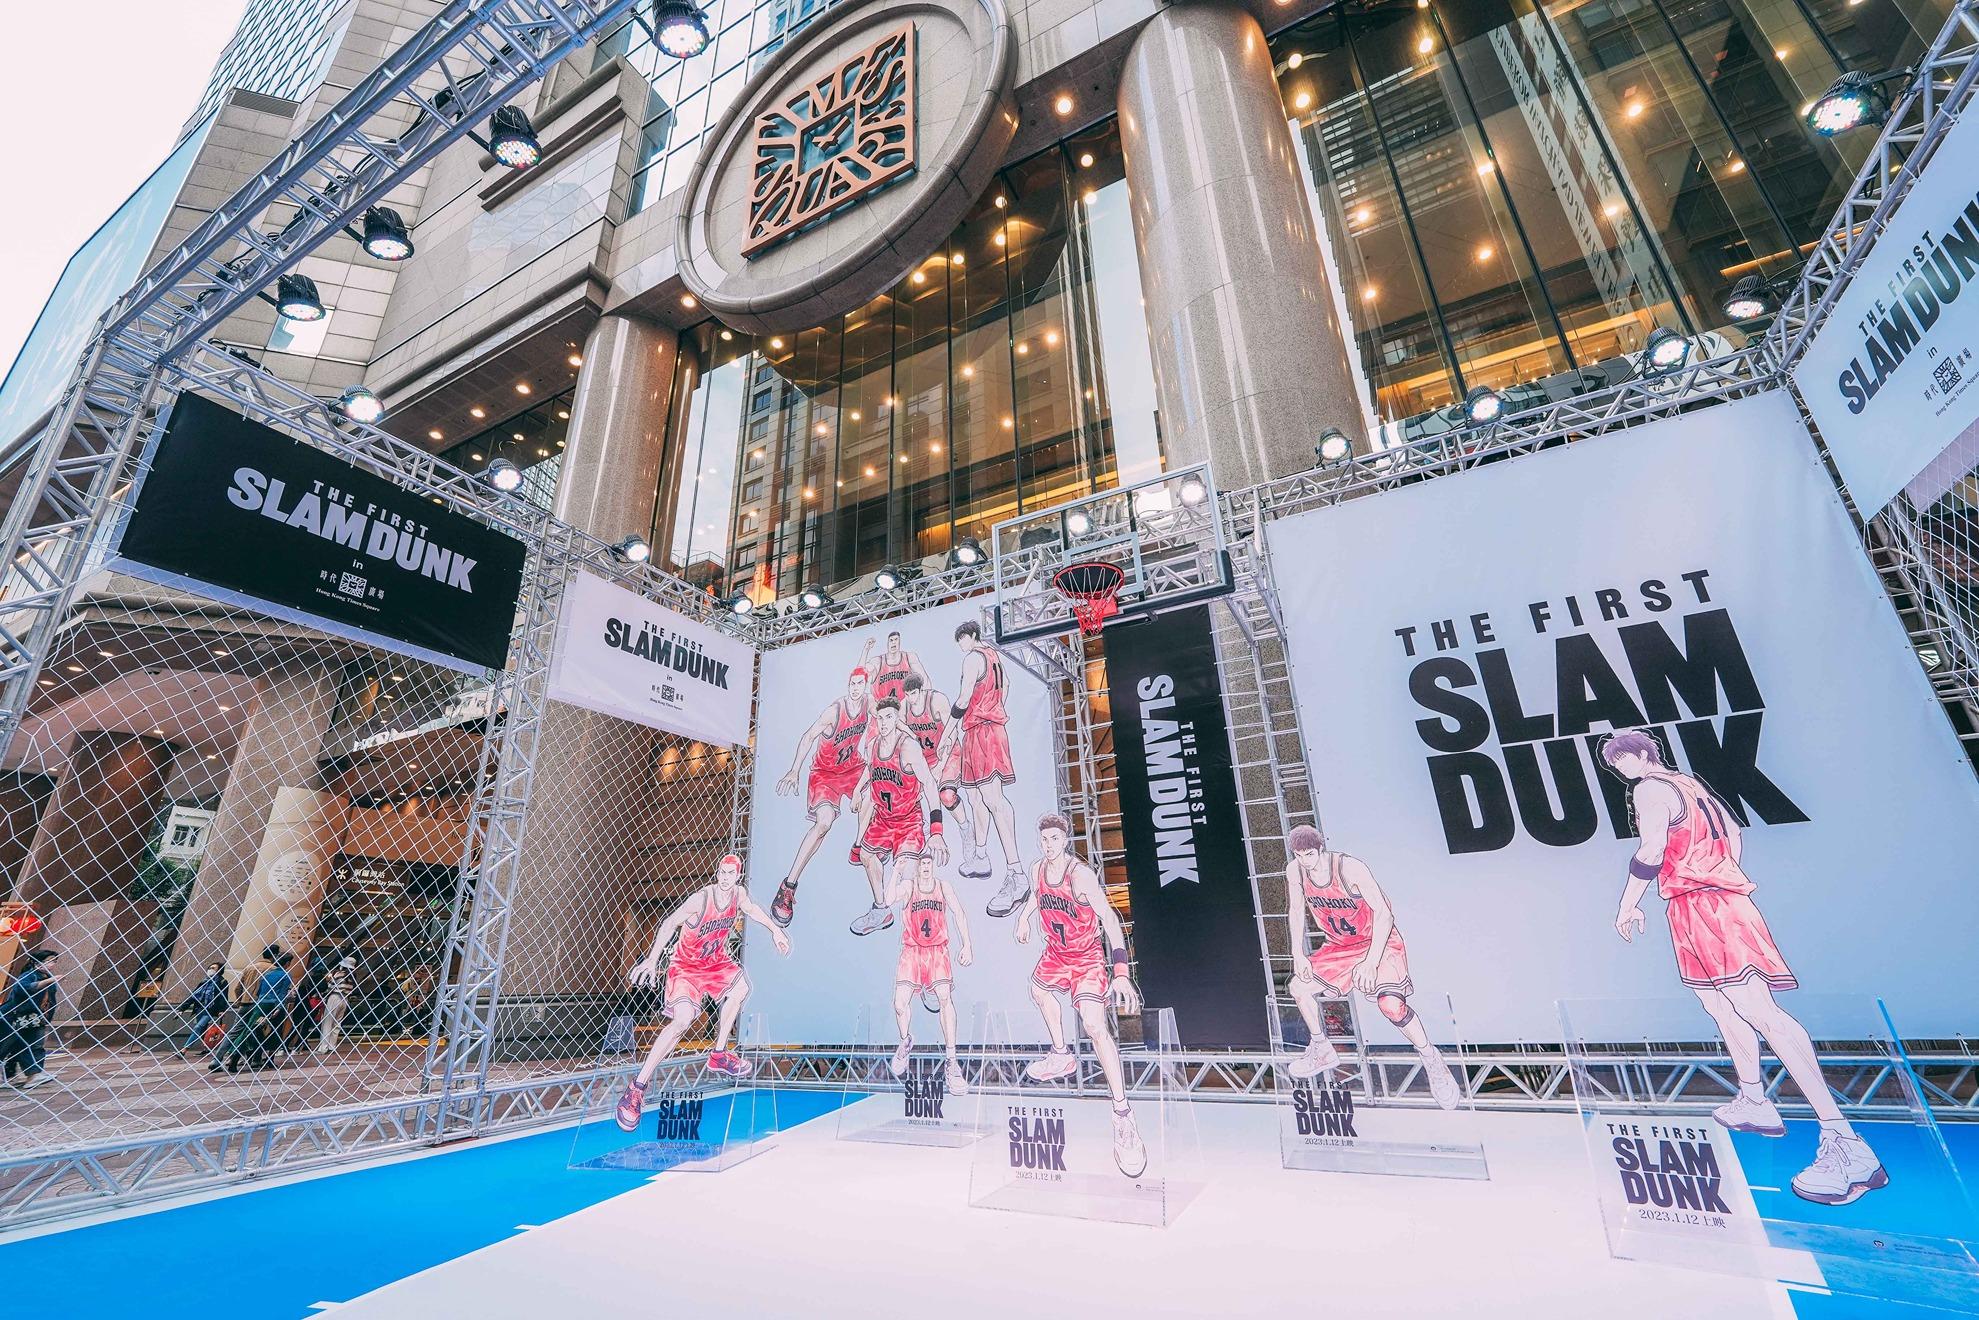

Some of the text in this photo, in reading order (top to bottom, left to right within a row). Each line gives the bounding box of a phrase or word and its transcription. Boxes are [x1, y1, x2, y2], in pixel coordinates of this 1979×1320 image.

[1859, 230, 1935, 336] THE FIRST
[1839, 300, 1921, 415] SLAM
[1927, 346, 1938, 359] in
[313, 480, 429, 538] THE FIRST
[227, 467, 478, 594] SLAM DUNK
[352, 559, 364, 570] in
[1394, 569, 1713, 657] THE FIRST
[643, 620, 703, 653] THE FIRST
[604, 617, 730, 690] SLAM DUNK
[1408, 608, 1767, 753] SLAM
[1136, 674, 1200, 888] SLAM DUNK
[1180, 721, 1207, 825] THE FIRST
[880, 791, 892, 812] 7
[920, 918, 931, 938] 4
[1051, 920, 1067, 946] 7
[1328, 916, 1356, 936] 14
[905, 1080, 943, 1099] SLAM
[1291, 1081, 1350, 1090] THE FIRST
[659, 1100, 703, 1119] SLAM
[905, 1099, 943, 1118] DUNK
[1008, 1107, 1063, 1117] THE FIRST
[1293, 1090, 1354, 1113] SLAM
[657, 1120, 700, 1140] DUNK
[1008, 1116, 1066, 1144] SLAM
[1296, 1112, 1358, 1137] DUNK
[1607, 1124, 1707, 1140] THE FIRST
[1010, 1142, 1066, 1171] DUNK
[1612, 1137, 1721, 1178] SLAM
[1620, 1170, 1732, 1214] DUNK
